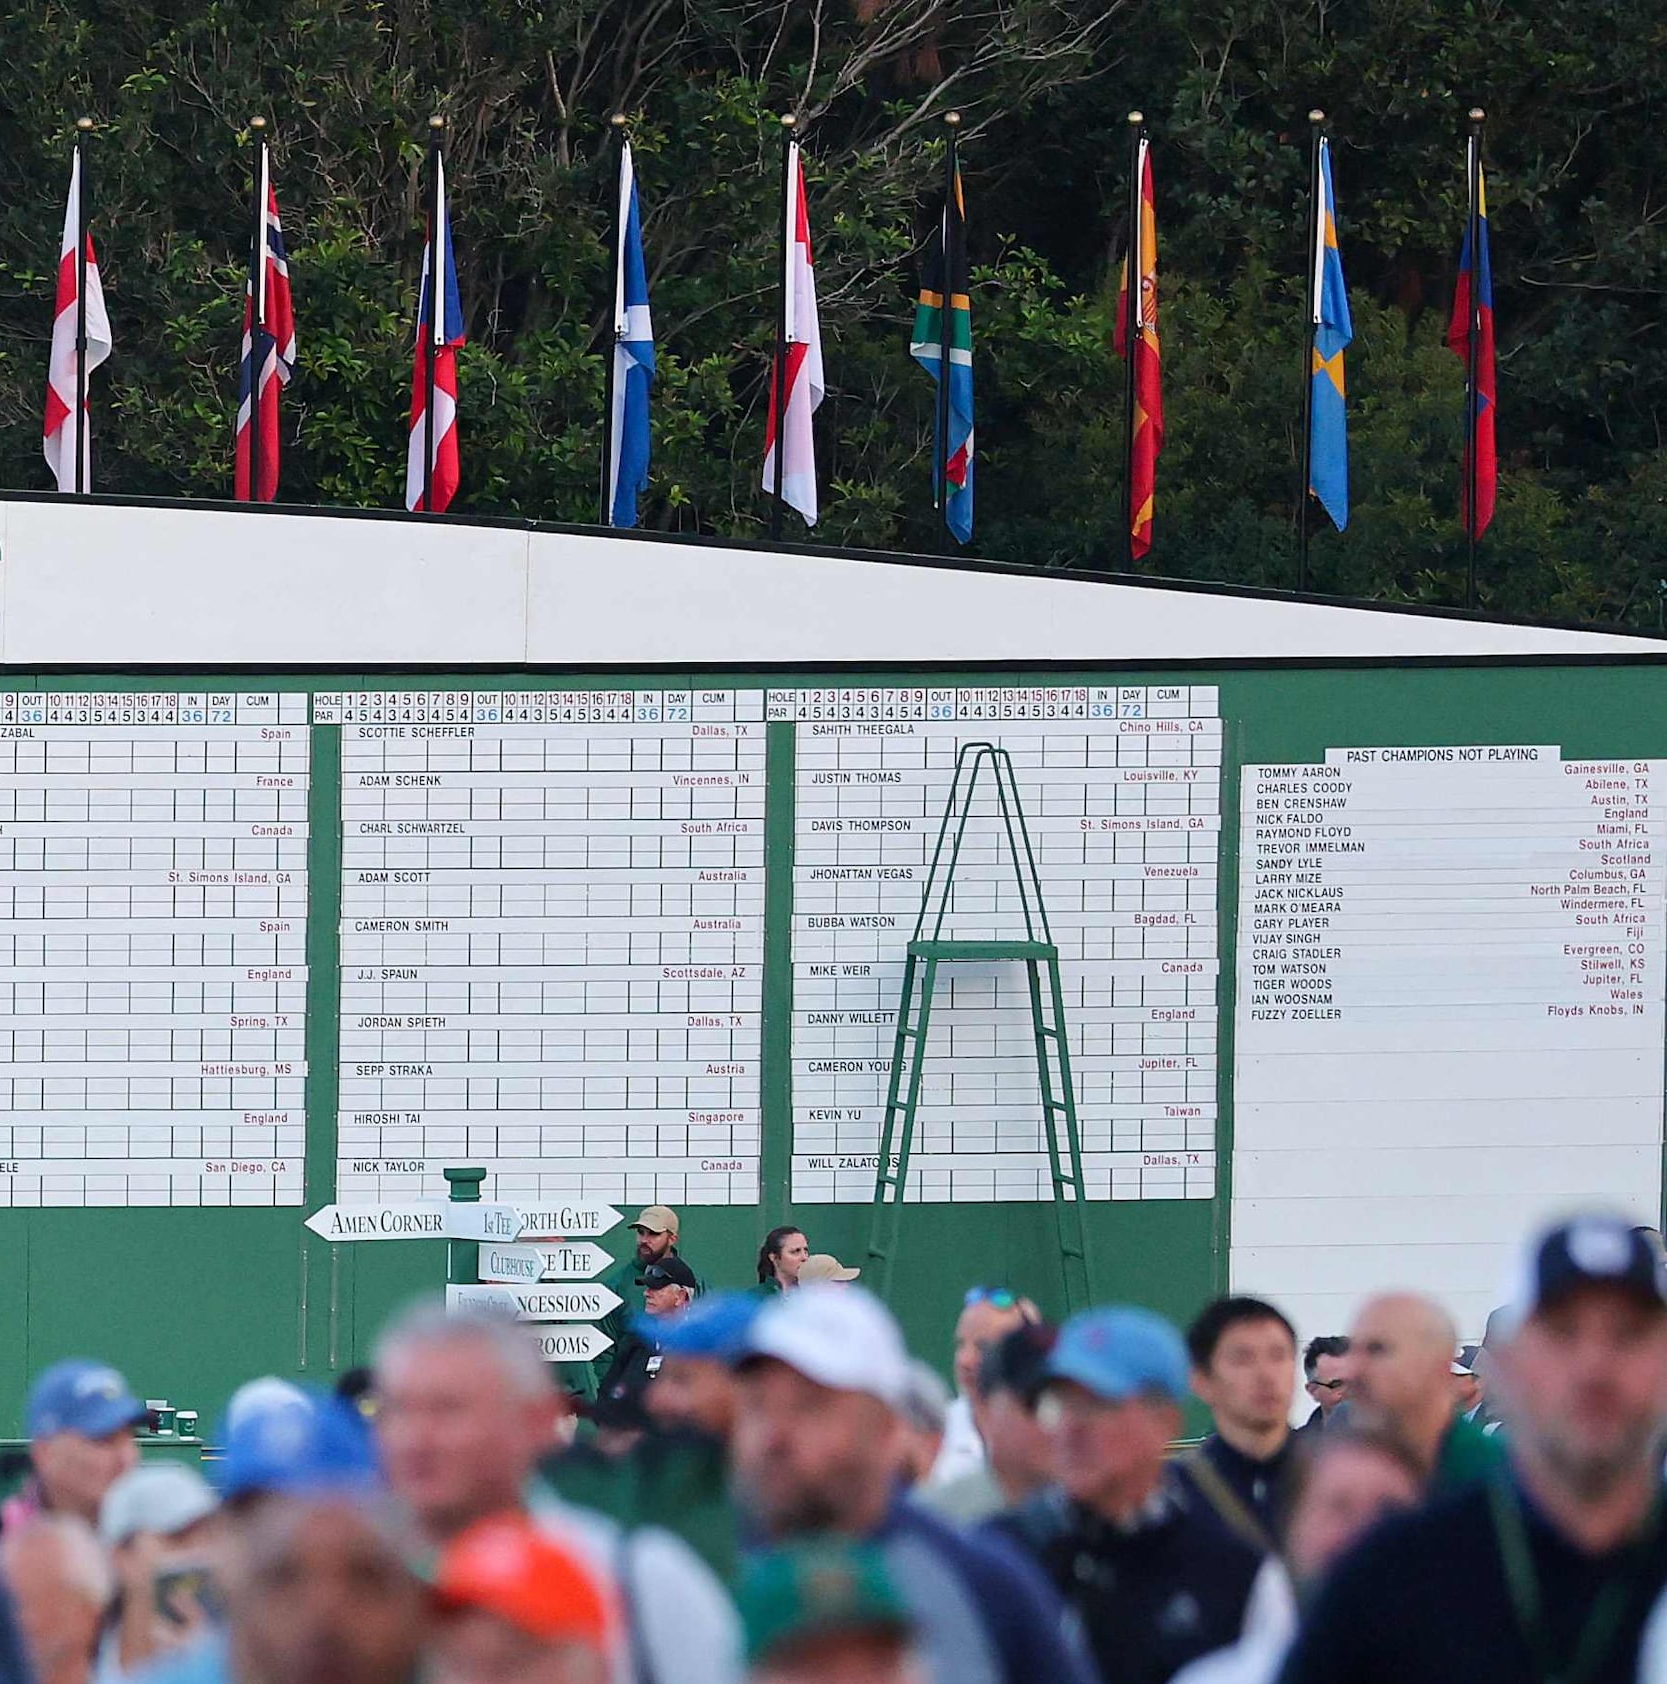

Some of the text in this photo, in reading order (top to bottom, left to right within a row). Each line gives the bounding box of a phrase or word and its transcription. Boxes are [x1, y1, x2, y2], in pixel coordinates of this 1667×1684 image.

[734, 725, 747, 736] TX
[812, 724, 914, 736] SAHITH THEEGALA
[1119, 721, 1151, 732] Chino
[1188, 720, 1203, 732] CA
[359, 727, 475, 738] SCOTTIE SCHEFFLER
[1347, 748, 1538, 763] PAST CHAMPIONS NOT PLAYING
[1258, 767, 1341, 779] TOMMY AARON
[1633, 762, 1649, 774] GA
[251, 824, 293, 836] Canada
[1253, 978, 1332, 990] TIGER WOODS
[1630, 973, 1643, 984] FL
[1251, 1008, 1341, 1020] FUZZY ZOELLER
[1547, 1005, 1584, 1018] Floyds
[1633, 1004, 1643, 1014] IN
[809, 1110, 861, 1120] KEVIN YU
[1163, 1106, 1201, 1116] Taiwan
[354, 1113, 420, 1124] HIROSHI TAI
[688, 1112, 744, 1124] Singapore
[205, 1162, 226, 1172] San
[271, 1161, 286, 1172] CA
[330, 1210, 442, 1234] AMEN CORNER
[561, 1207, 599, 1230] GATE
[559, 1249, 591, 1272] TEE
